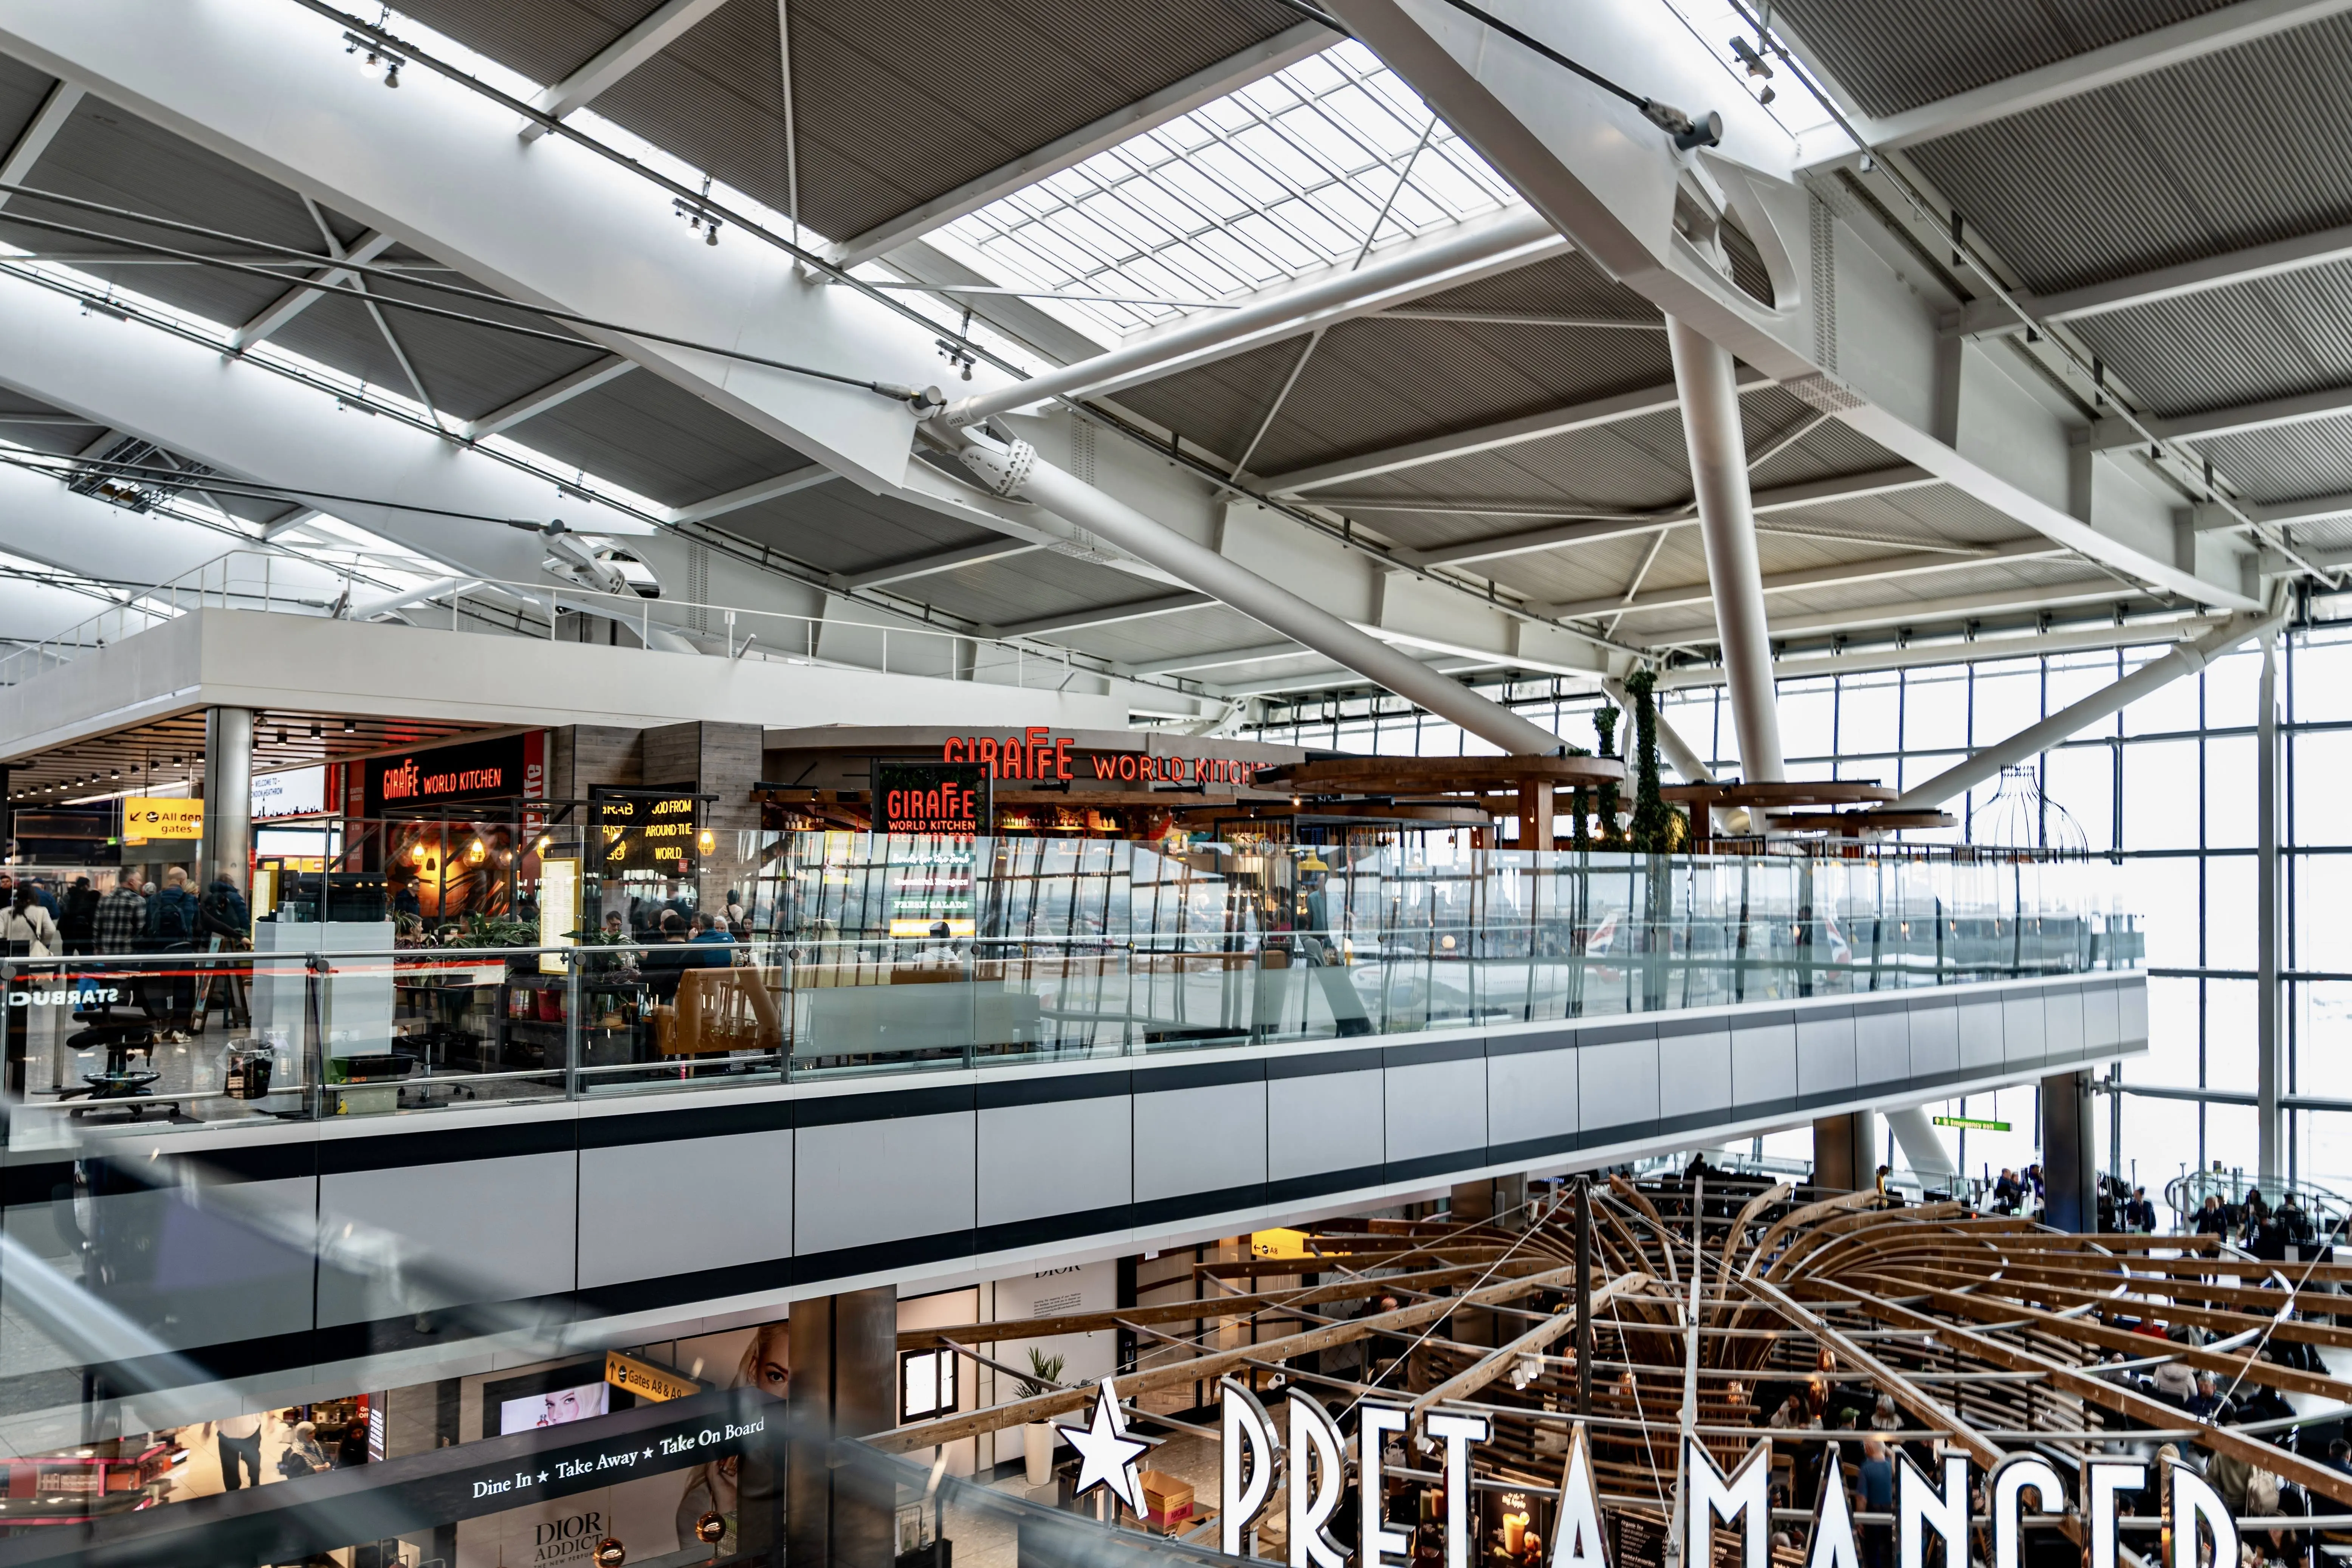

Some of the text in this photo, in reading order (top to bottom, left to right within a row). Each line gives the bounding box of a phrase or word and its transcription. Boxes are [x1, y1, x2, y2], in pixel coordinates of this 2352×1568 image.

[944, 727, 1276, 785] GIRAFFE WORLD KITCH
[383, 758, 501, 799] GIRAFFE WORLD KITCHEN
[264, 787, 283, 796] HEATHROW
[888, 782, 976, 819] GIRAFFE
[669, 799, 692, 813] FROM
[180, 813, 203, 823] dep
[888, 820, 976, 831] WORLD KITCHEN
[161, 826, 192, 835] gates
[645, 823, 693, 837] AROUND THE
[948, 832, 975, 844] FOOD
[655, 847, 682, 860] WORLD
[1951, 1119, 1982, 1129] Emergency
[628, 1370, 682, 1399] Gates A8 & A9
[659, 1416, 764, 1456] Take On Board
[555, 1451, 638, 1479] Take Away
[1221, 1376, 1494, 1568] PRET
[1547, 1420, 1614, 1568] A
[473, 1472, 532, 1498] Dine In
[534, 1512, 603, 1547] DIOR
[535, 1533, 603, 1562] ADDICT
[568, 1551, 595, 1562] PERFUM
